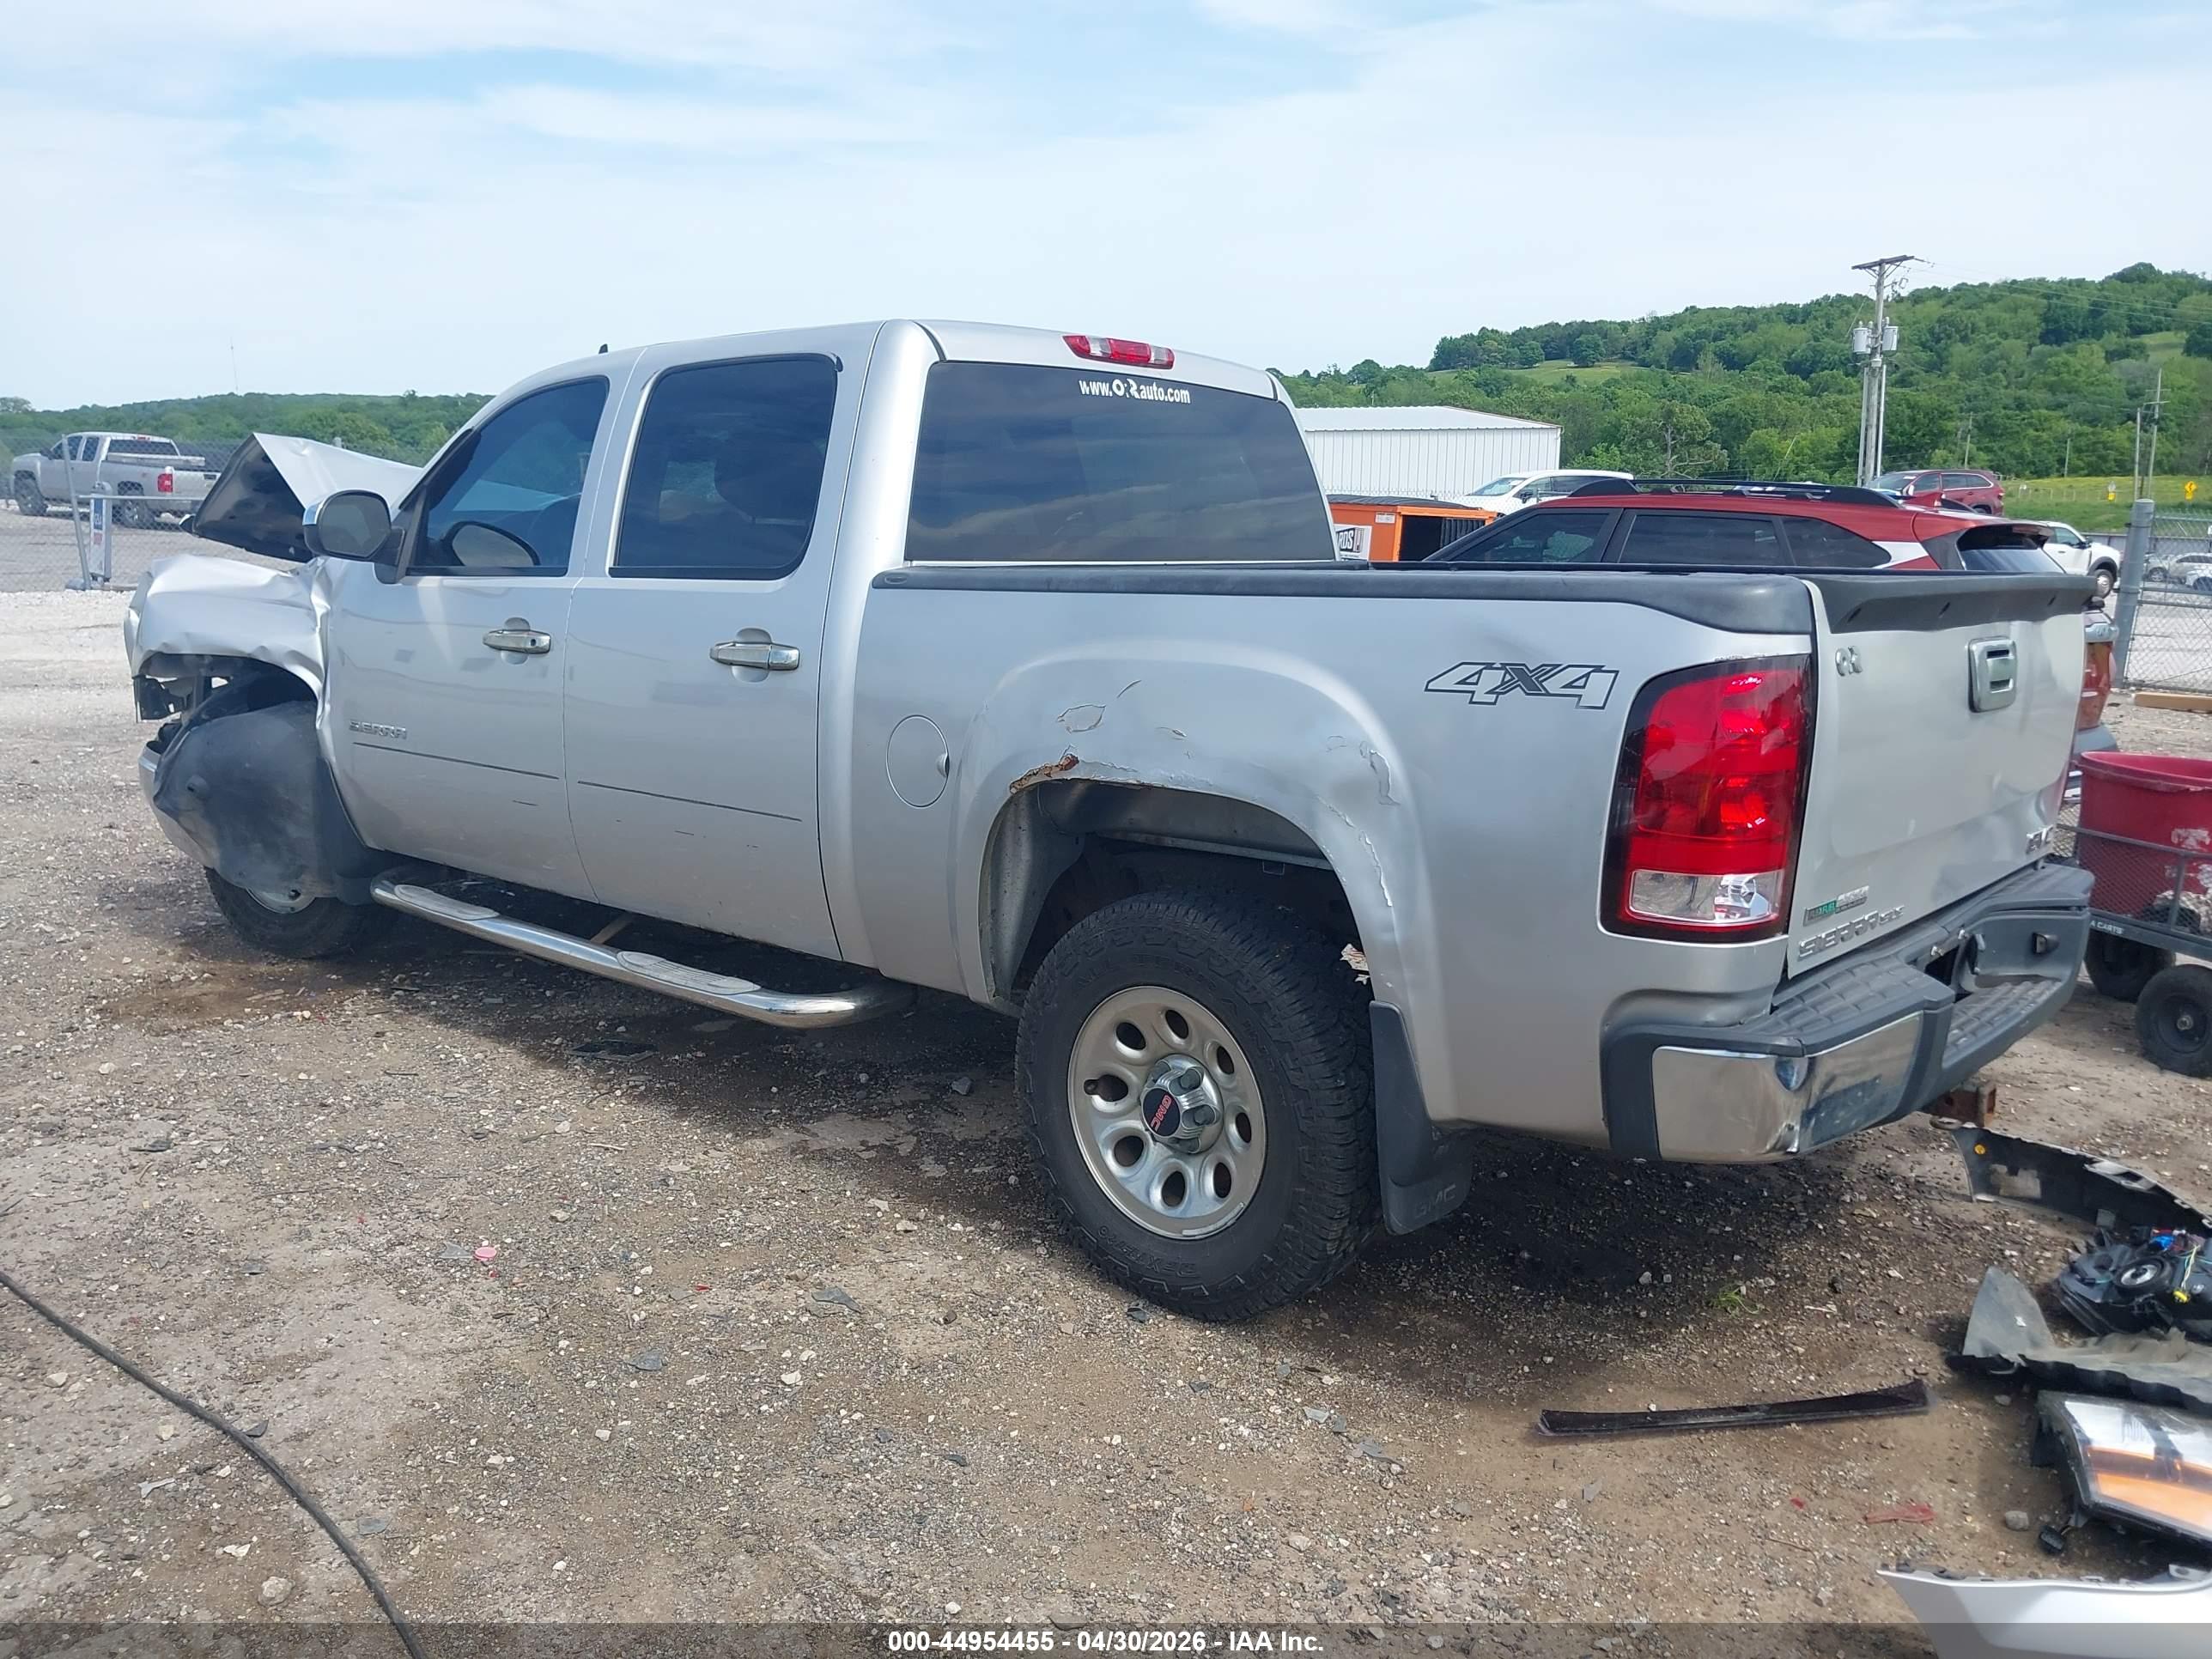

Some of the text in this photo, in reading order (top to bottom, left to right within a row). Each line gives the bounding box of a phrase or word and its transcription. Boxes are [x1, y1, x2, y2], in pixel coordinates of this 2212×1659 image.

[349, 720, 407, 739] SIERRA
[1798, 911, 1879, 958] SIERRA
[1150, 1095, 1172, 1133] GMC
